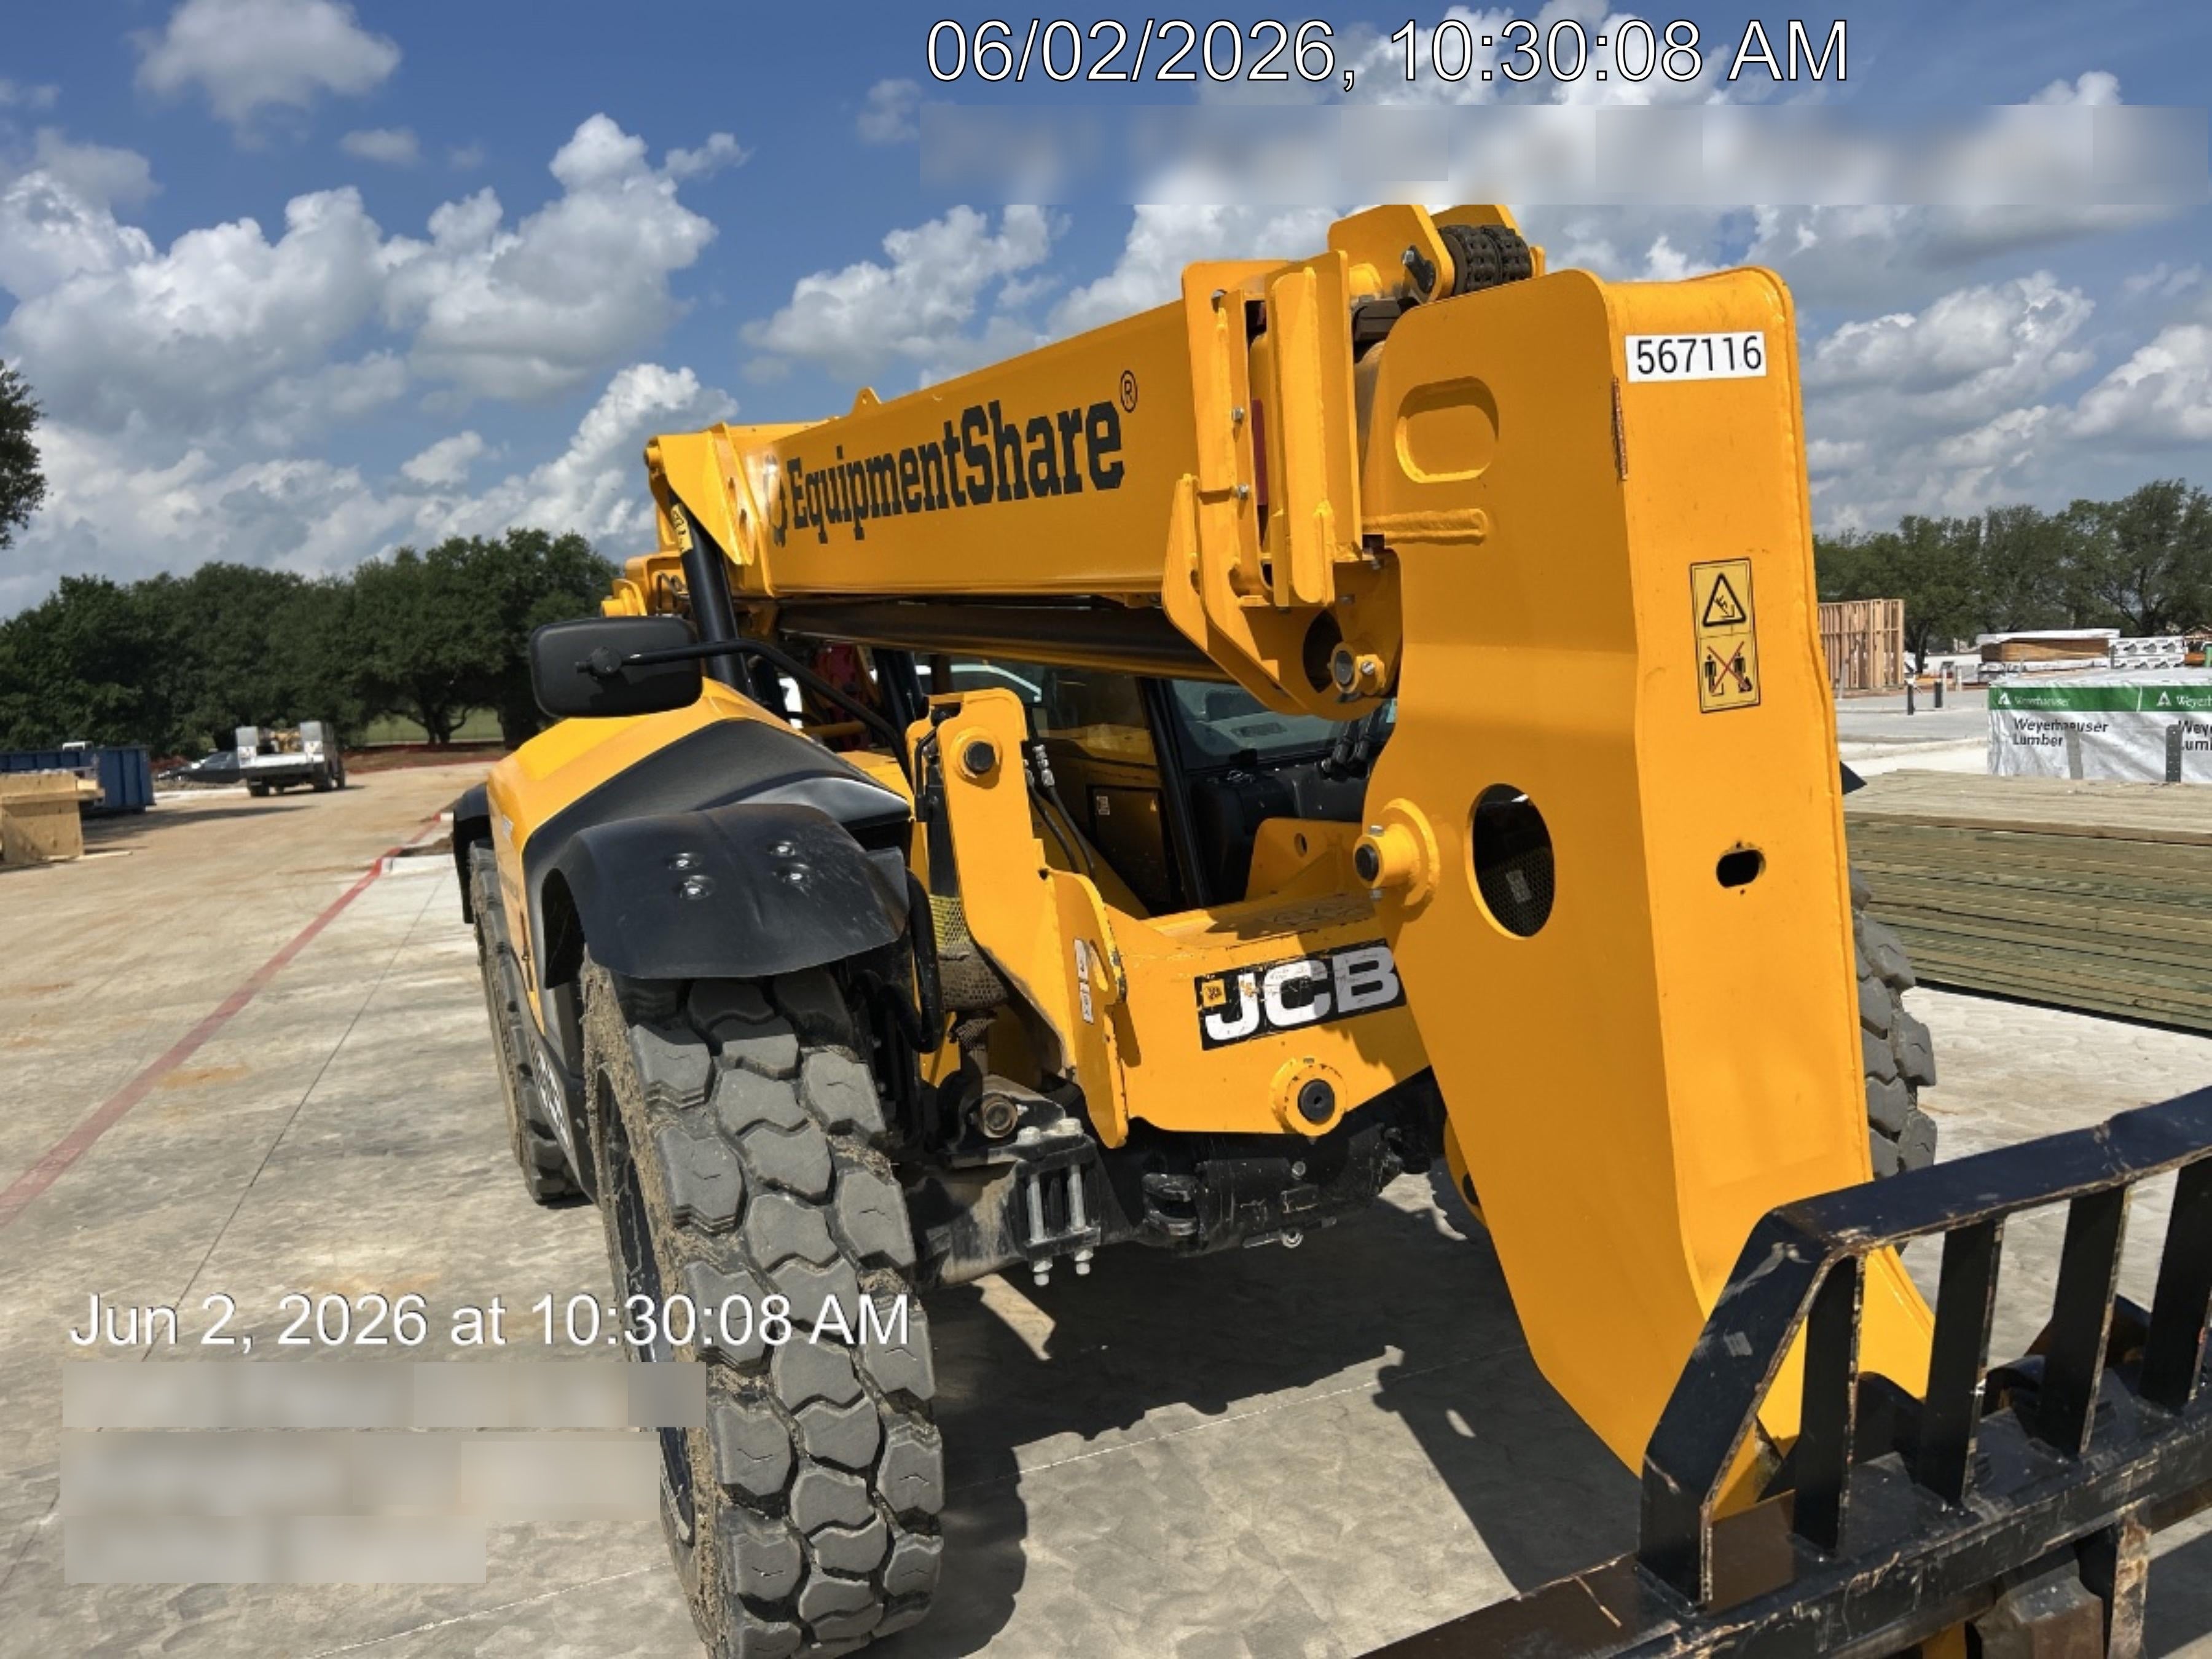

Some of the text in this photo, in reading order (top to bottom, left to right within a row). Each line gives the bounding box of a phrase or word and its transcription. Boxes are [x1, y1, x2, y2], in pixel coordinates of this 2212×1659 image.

[1636, 335, 1762, 374] 567116
[2012, 734, 2063, 747] Lumber
[1205, 946, 1400, 1040] JCB
